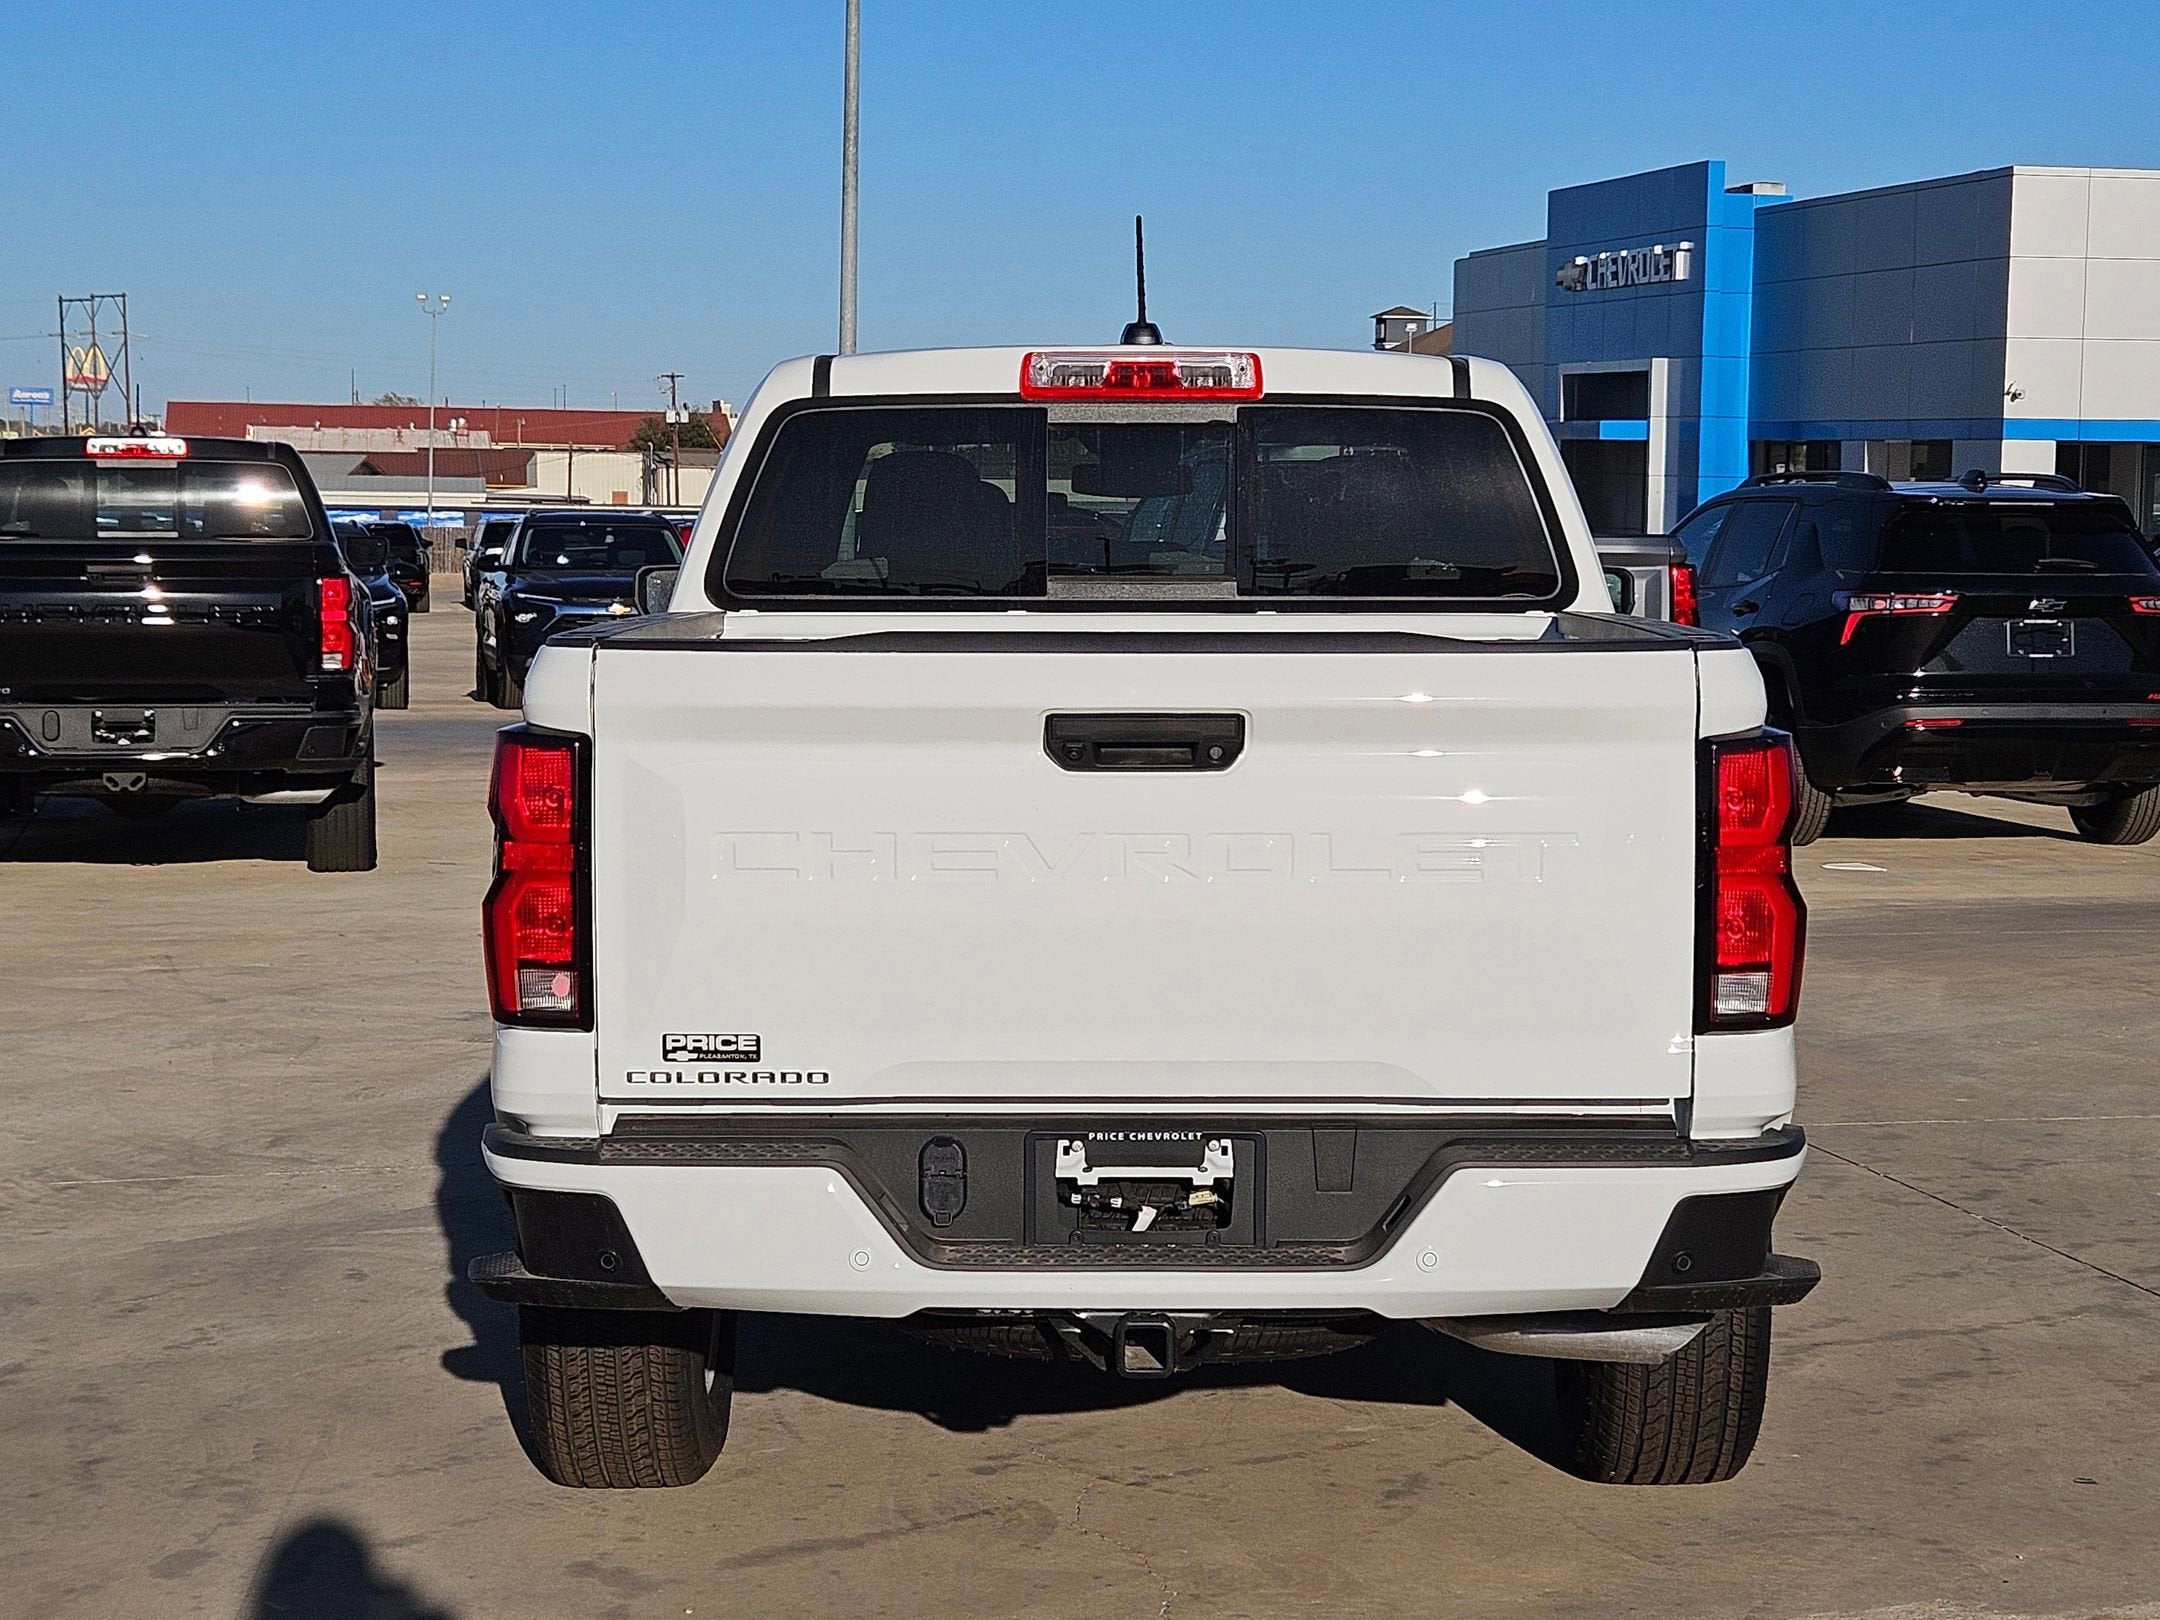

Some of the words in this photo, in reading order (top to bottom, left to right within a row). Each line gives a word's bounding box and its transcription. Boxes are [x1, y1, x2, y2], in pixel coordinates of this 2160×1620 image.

[1586, 241, 1694, 290] CHEVROLET
[711, 831, 1579, 882] CHEVROLET
[665, 1035, 757, 1051] PRICE
[626, 1071, 830, 1084] COLORADO
[1088, 1131, 1125, 1141] PRICE
[1129, 1131, 1203, 1141] CHEVROLET
